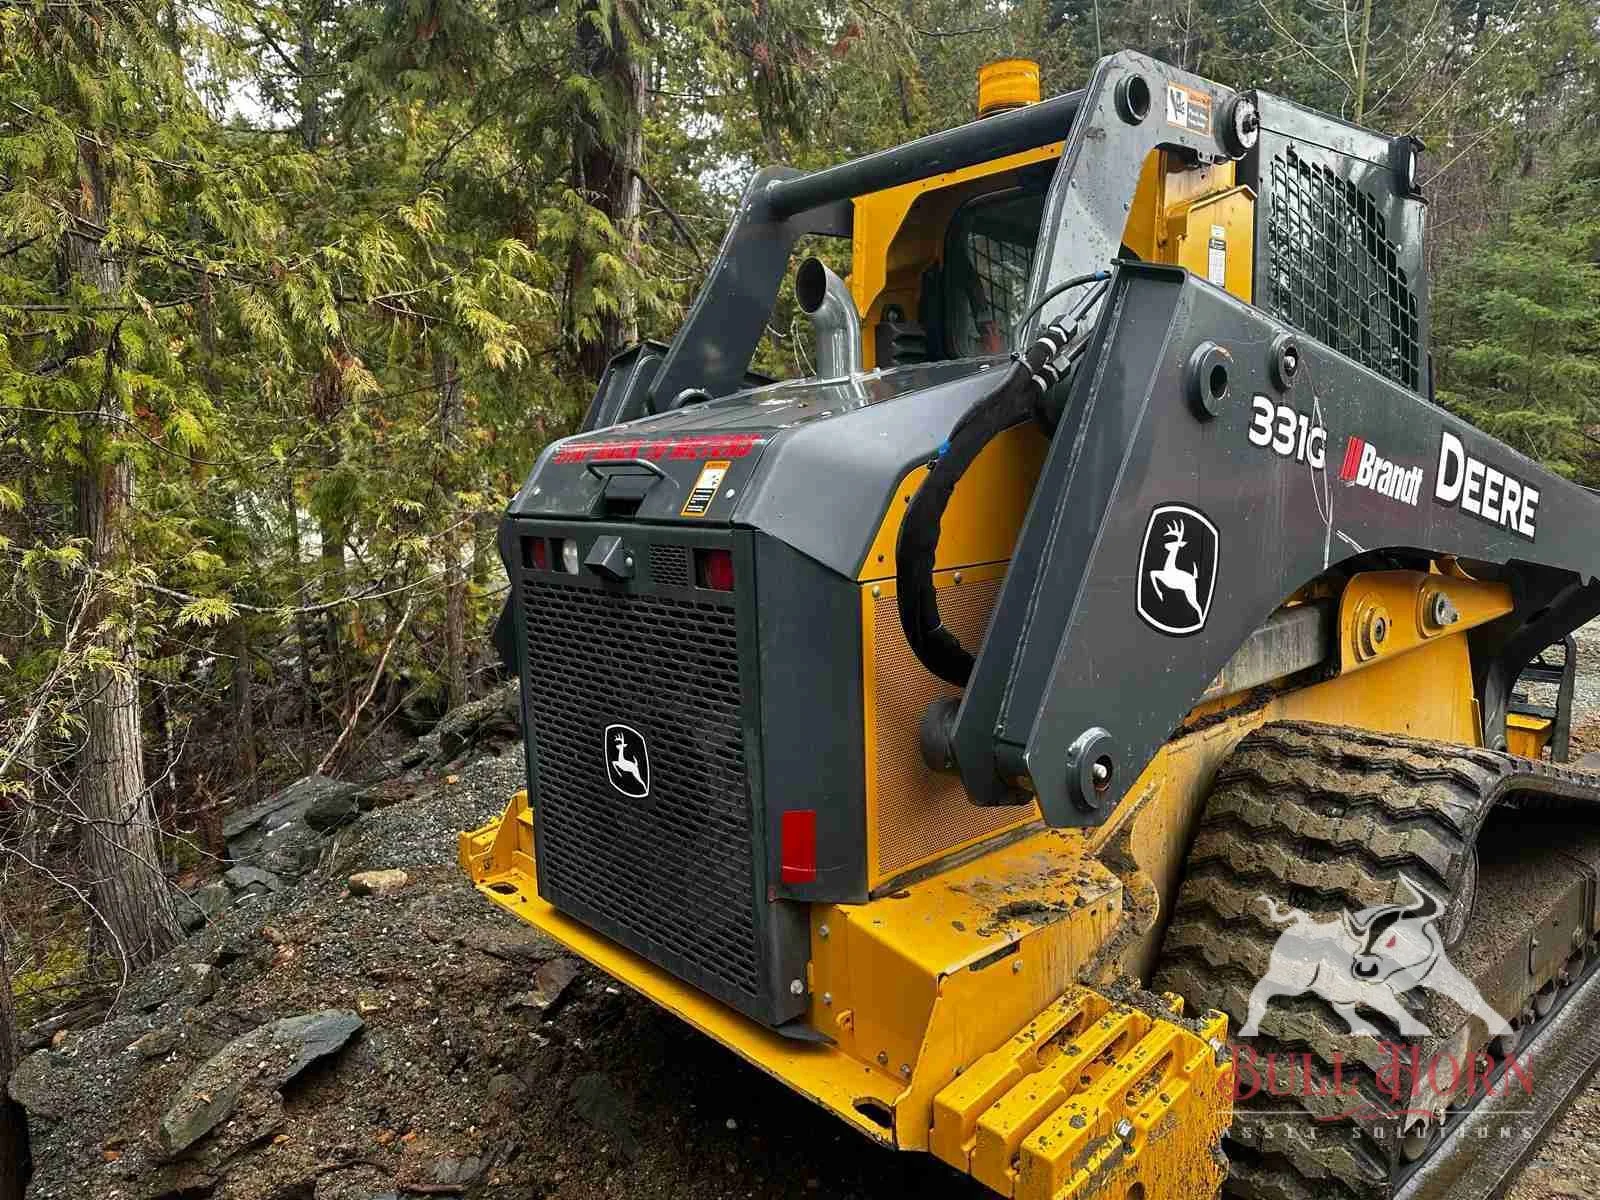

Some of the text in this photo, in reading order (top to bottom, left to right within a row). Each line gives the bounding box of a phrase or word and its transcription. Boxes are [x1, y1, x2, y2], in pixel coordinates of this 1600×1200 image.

[1249, 396, 1328, 469] 331G
[1355, 441, 1424, 507] Brandt
[1435, 431, 1540, 538] DEERE
